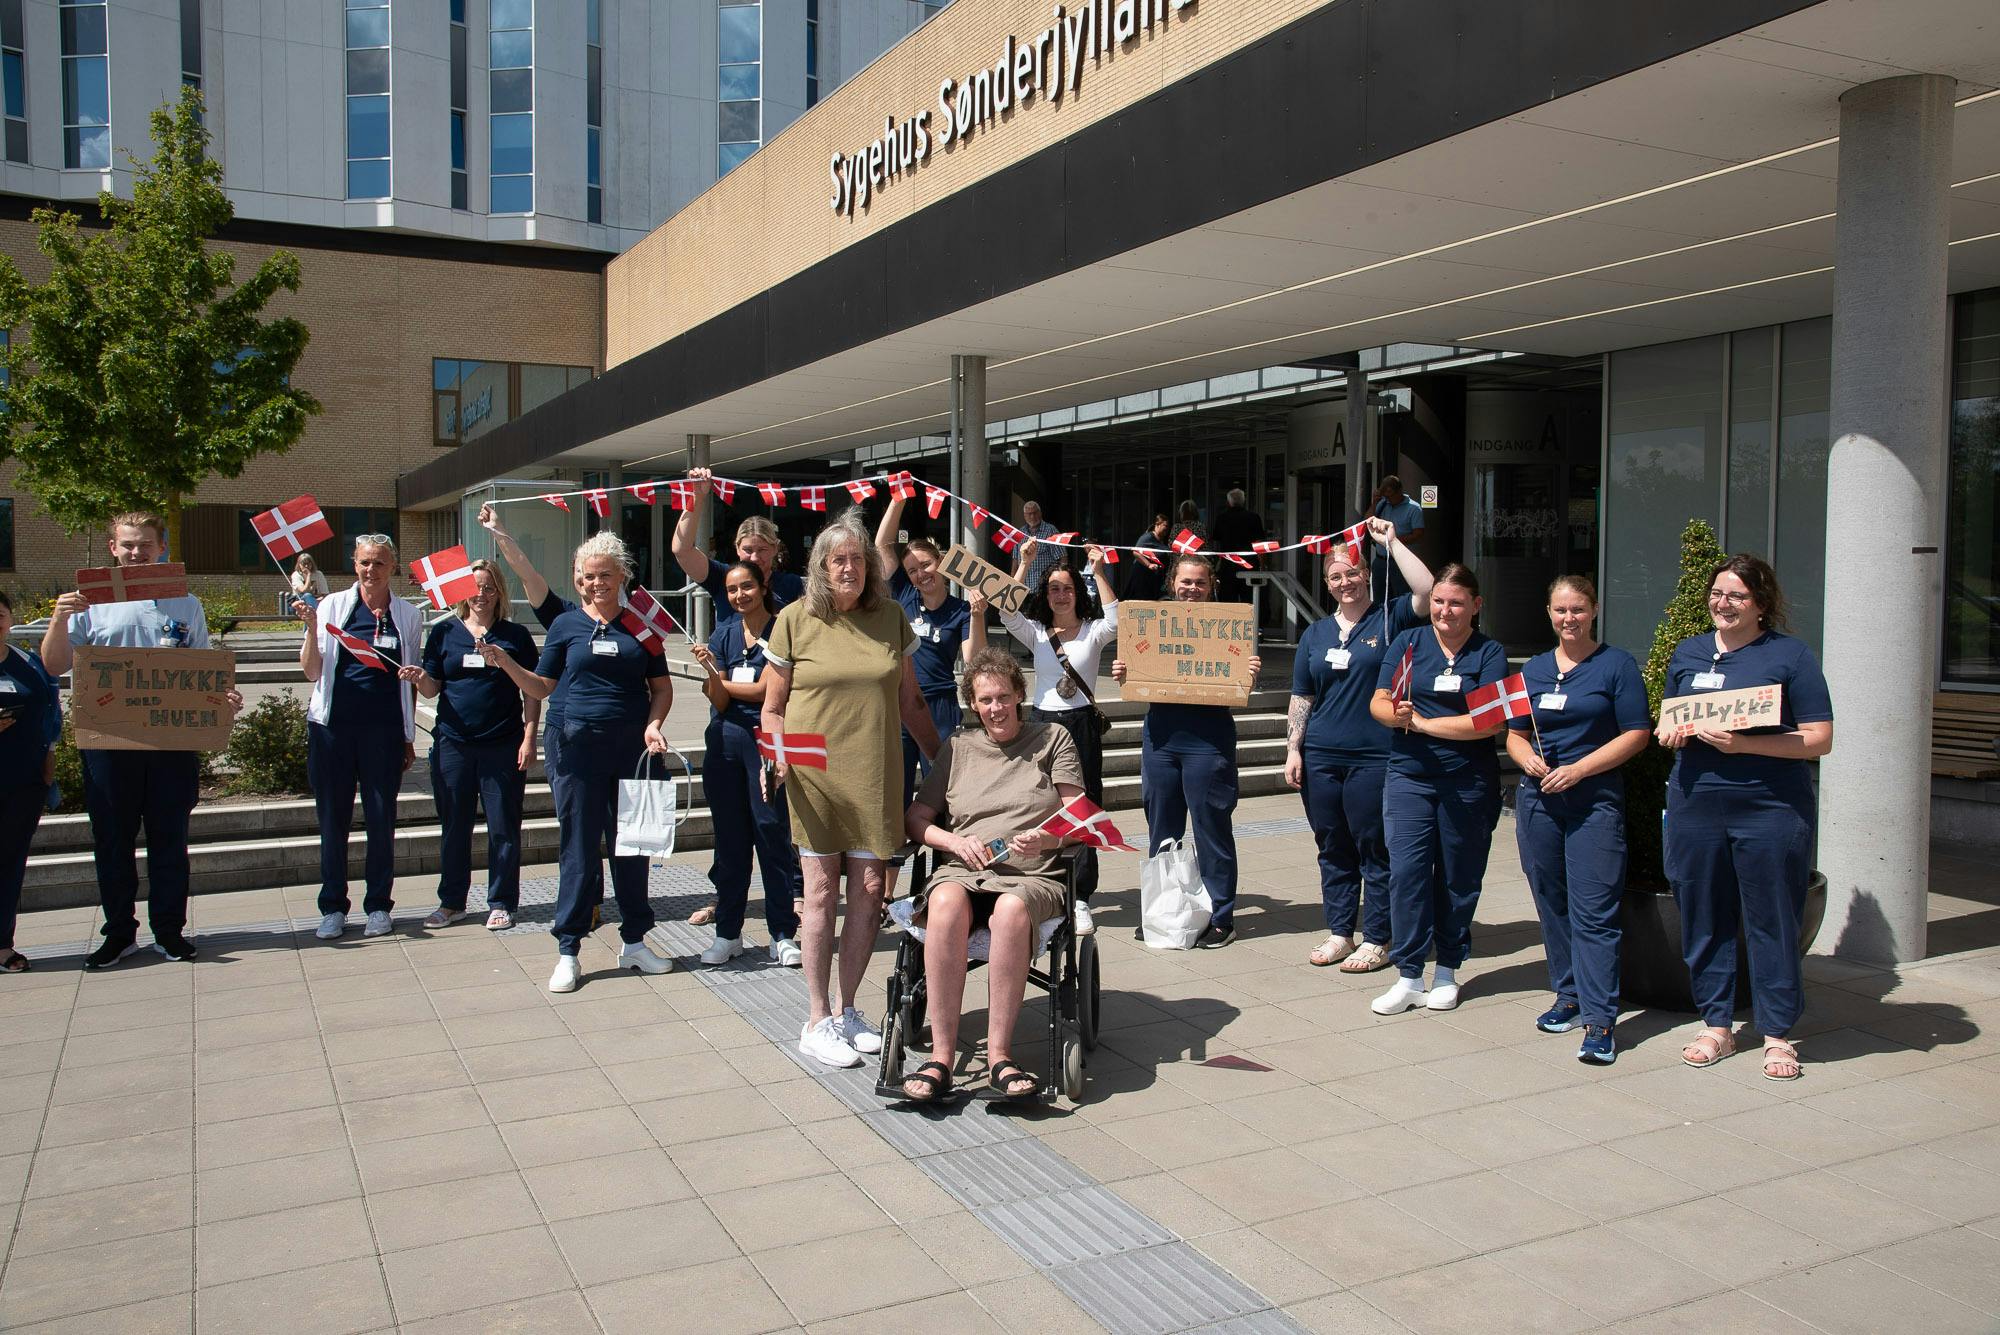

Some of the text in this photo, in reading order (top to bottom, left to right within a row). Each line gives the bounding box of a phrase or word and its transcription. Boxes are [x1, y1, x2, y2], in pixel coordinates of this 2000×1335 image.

[830, 0, 1199, 216] Sygehus Sønderjyllan
[1332, 422, 1347, 458] A
[1468, 413, 1561, 452] INDGANG A
[945, 549, 1028, 614] LUCAS
